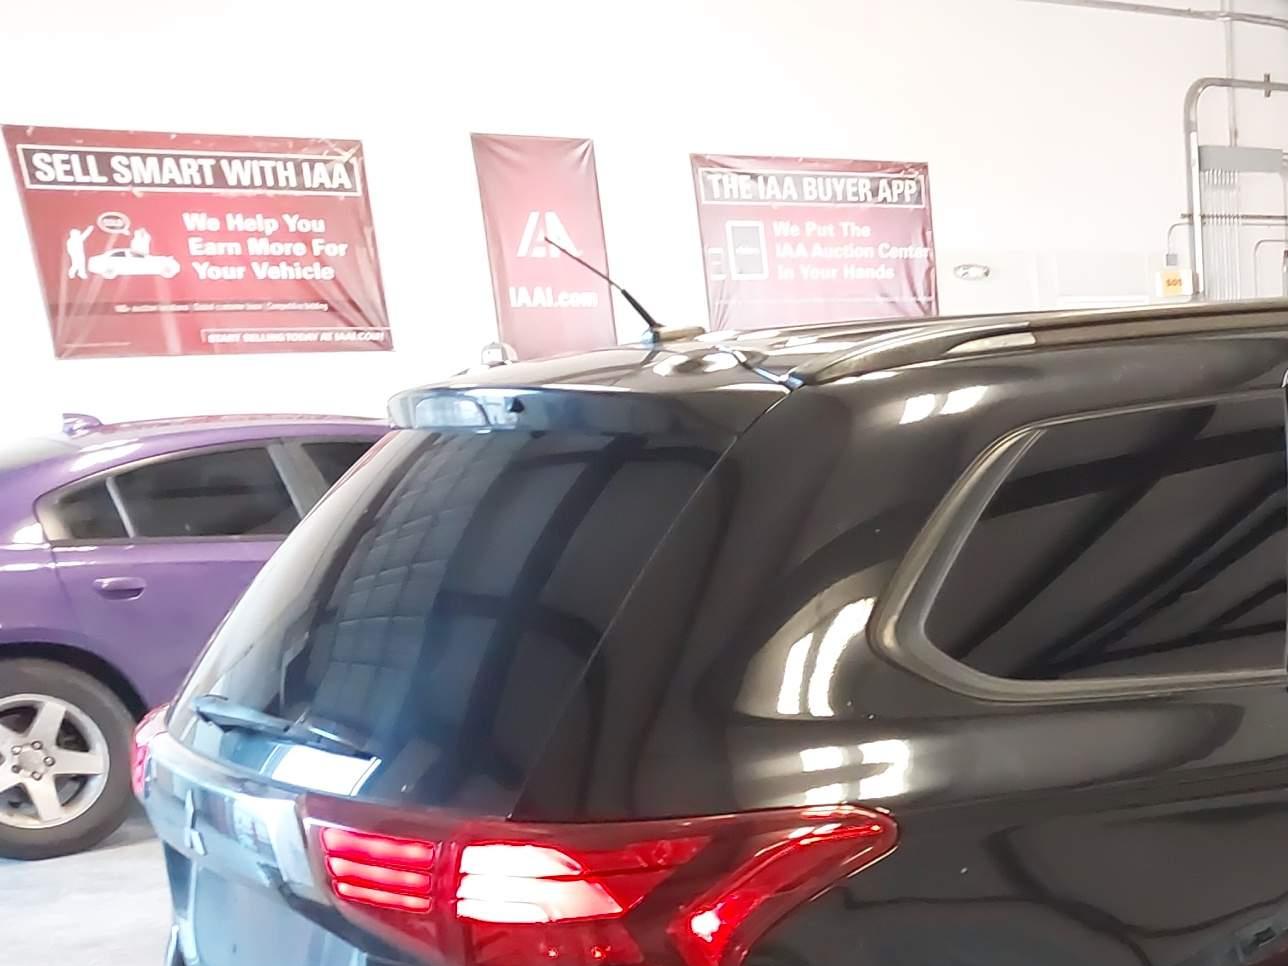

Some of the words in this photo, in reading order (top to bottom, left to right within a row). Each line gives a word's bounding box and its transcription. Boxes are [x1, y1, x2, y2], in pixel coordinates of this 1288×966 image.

[32, 152, 109, 183] SELL
[111, 155, 216, 186] SMART
[219, 158, 298, 188] WITH
[301, 161, 352, 189] IAA
[707, 173, 752, 200] THE
[757, 175, 798, 201] IAA
[802, 177, 872, 202] BUYER
[878, 178, 917, 204] APP
[182, 212, 221, 232] We
[225, 213, 279, 236] Help
[281, 213, 326, 233] You
[773, 220, 801, 237] We
[805, 221, 836, 237] Put
[840, 221, 872, 238] The
[188, 237, 242, 256] Earn
[247, 237, 307, 256] More
[311, 238, 348, 257] For
[775, 241, 808, 258] IAA
[812, 242, 876, 259] Auction
[878, 242, 930, 260] Center
[192, 261, 246, 280] Your
[251, 261, 336, 280] Vehicle
[800, 264, 838, 281] Your
[843, 264, 895, 281] Hands
